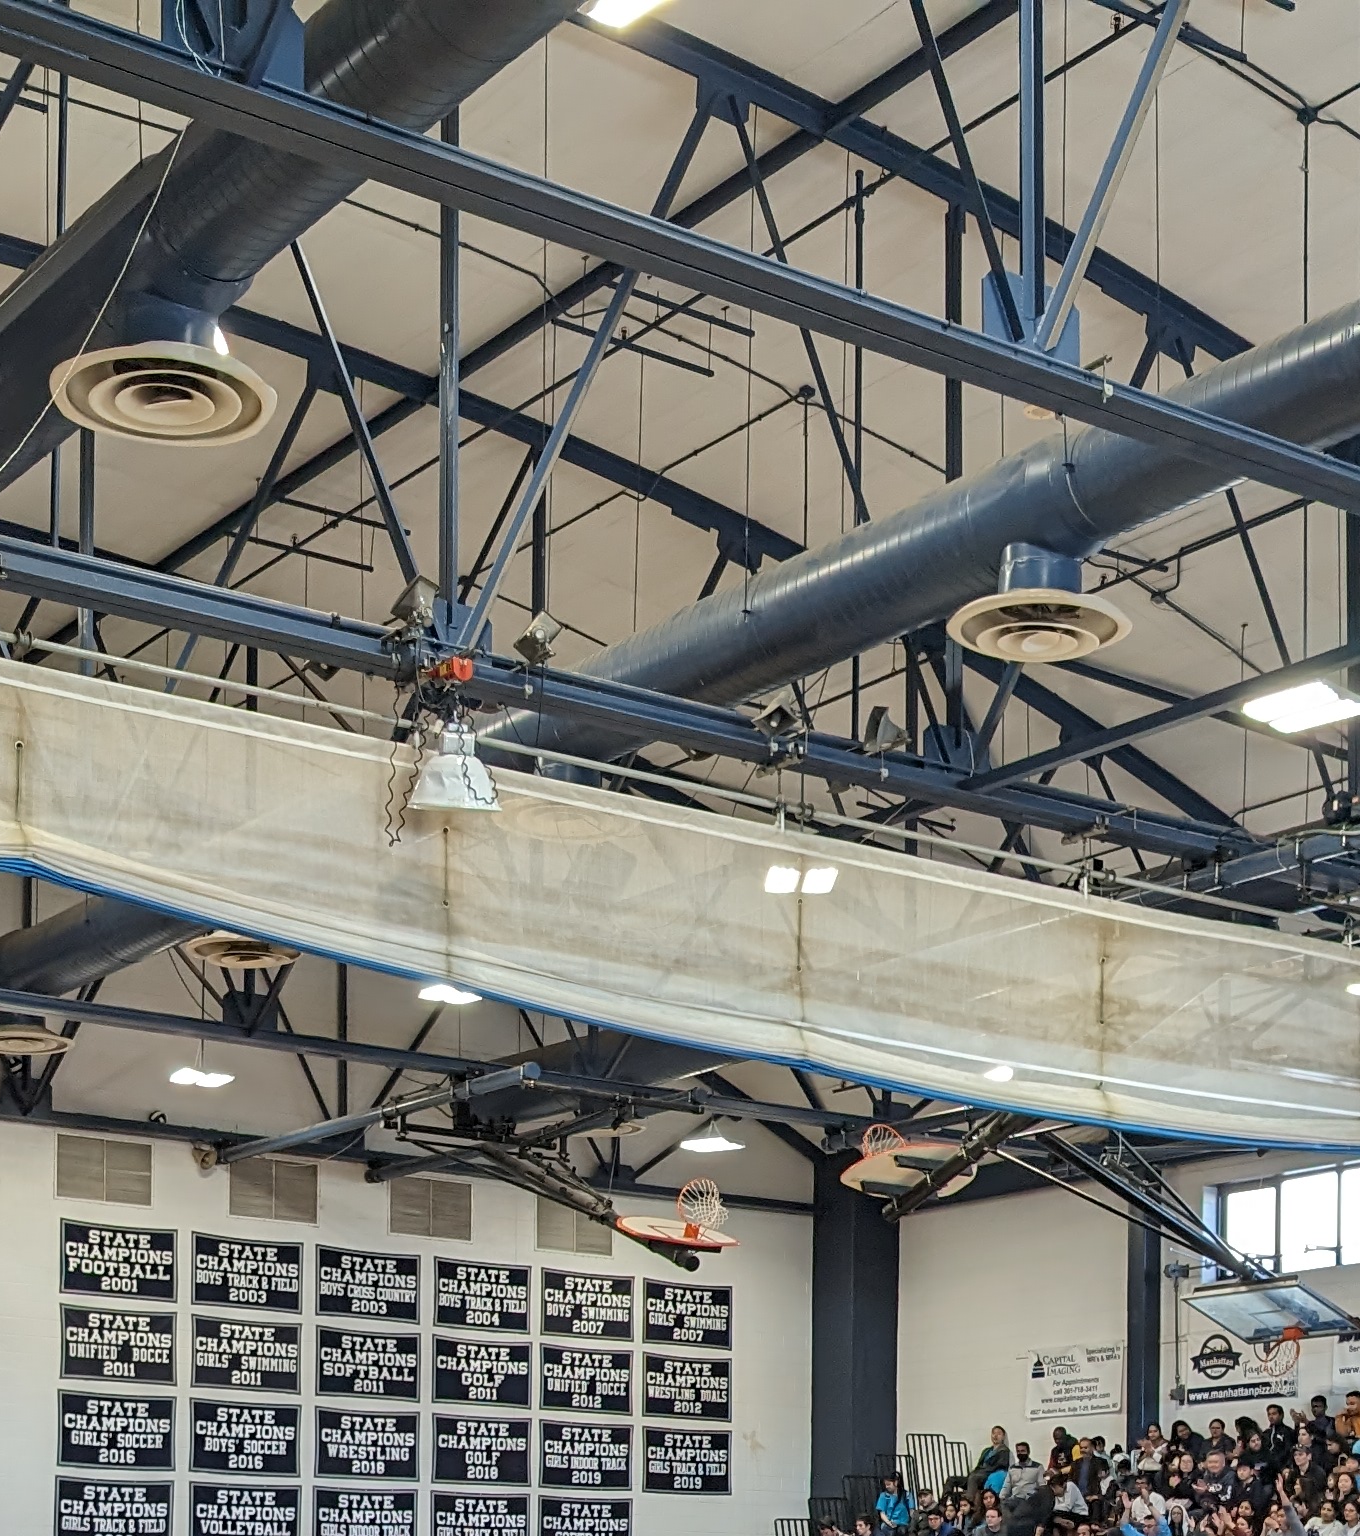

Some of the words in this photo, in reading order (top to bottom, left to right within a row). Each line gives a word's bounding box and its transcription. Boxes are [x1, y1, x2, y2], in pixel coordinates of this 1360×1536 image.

[89, 1230, 151, 1249] STATE
[65, 1242, 173, 1264] CHAMPIONS
[68, 1258, 170, 1280] FOOTBALL
[101, 1277, 138, 1292] 2001
[565, 1277, 612, 1292] STATE
[544, 1289, 630, 1307] CHAMPIONS
[582, 1307, 629, 1322] SWIMMING
[572, 1320, 604, 1334] 2007
[342, 1335, 397, 1352] STATE
[321, 1347, 416, 1367] CHAMPIONS
[323, 1362, 414, 1382] SOFTBALL
[354, 1379, 384, 1393] 2011
[87, 1400, 149, 1417] STATE
[64, 1414, 170, 1433] CHAMPIONS
[456, 1421, 509, 1436] STATE
[71, 1430, 112, 1447] GIRLS'
[117, 1434, 163, 1448] SOCCER
[438, 1435, 526, 1451] CHAMPIONS
[99, 1449, 136, 1464] 2016
[465, 1451, 501, 1465] GOLF
[467, 1466, 498, 1479] 2018
